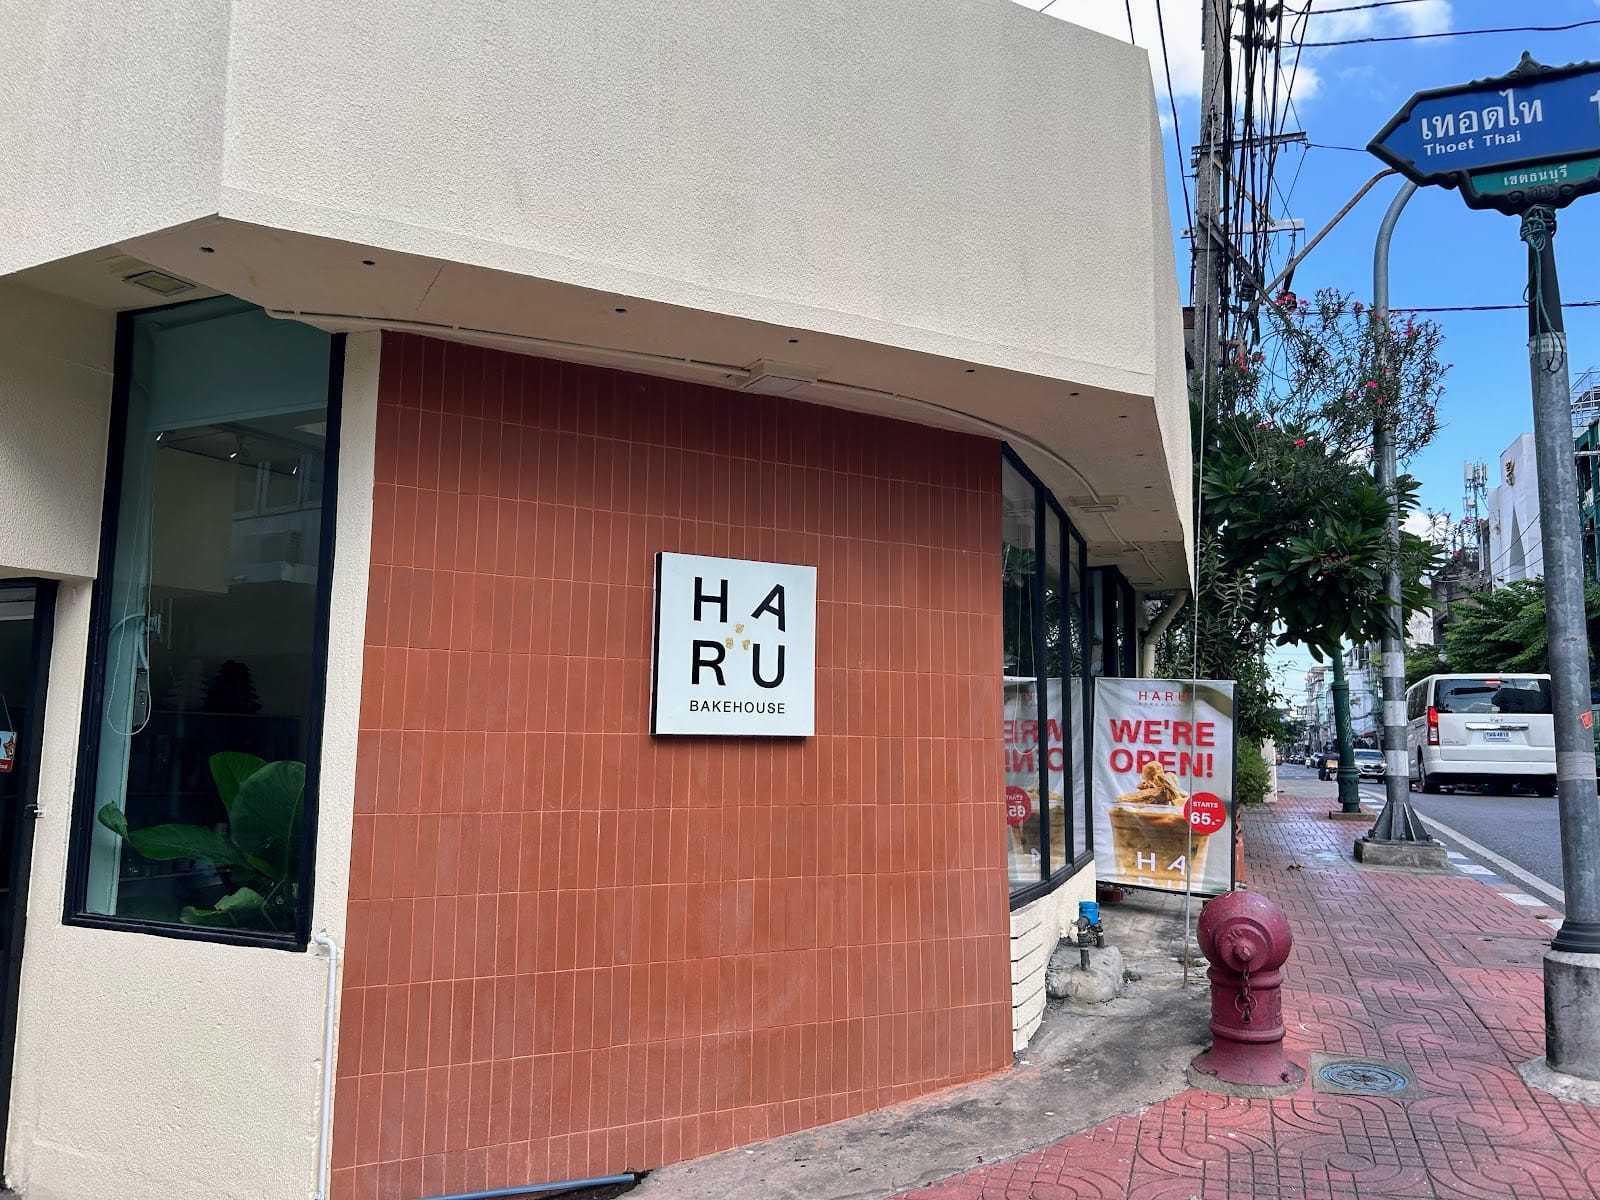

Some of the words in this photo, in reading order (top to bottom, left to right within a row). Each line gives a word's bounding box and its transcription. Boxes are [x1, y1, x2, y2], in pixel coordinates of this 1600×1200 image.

[1421, 88, 1543, 140] เทอดไท
[1424, 137, 1475, 156] Thoet
[1483, 130, 1521, 147] Thai
[1504, 164, 1567, 186] เขตธนบุรี
[689, 700, 786, 714] BAKEHOUSE
[1138, 690, 1189, 703] HARU
[1109, 718, 1216, 748] WE'RE
[1109, 748, 1214, 778] OPEN!
[1192, 801, 1219, 809] STARTS
[1190, 811, 1221, 826] 65.-
